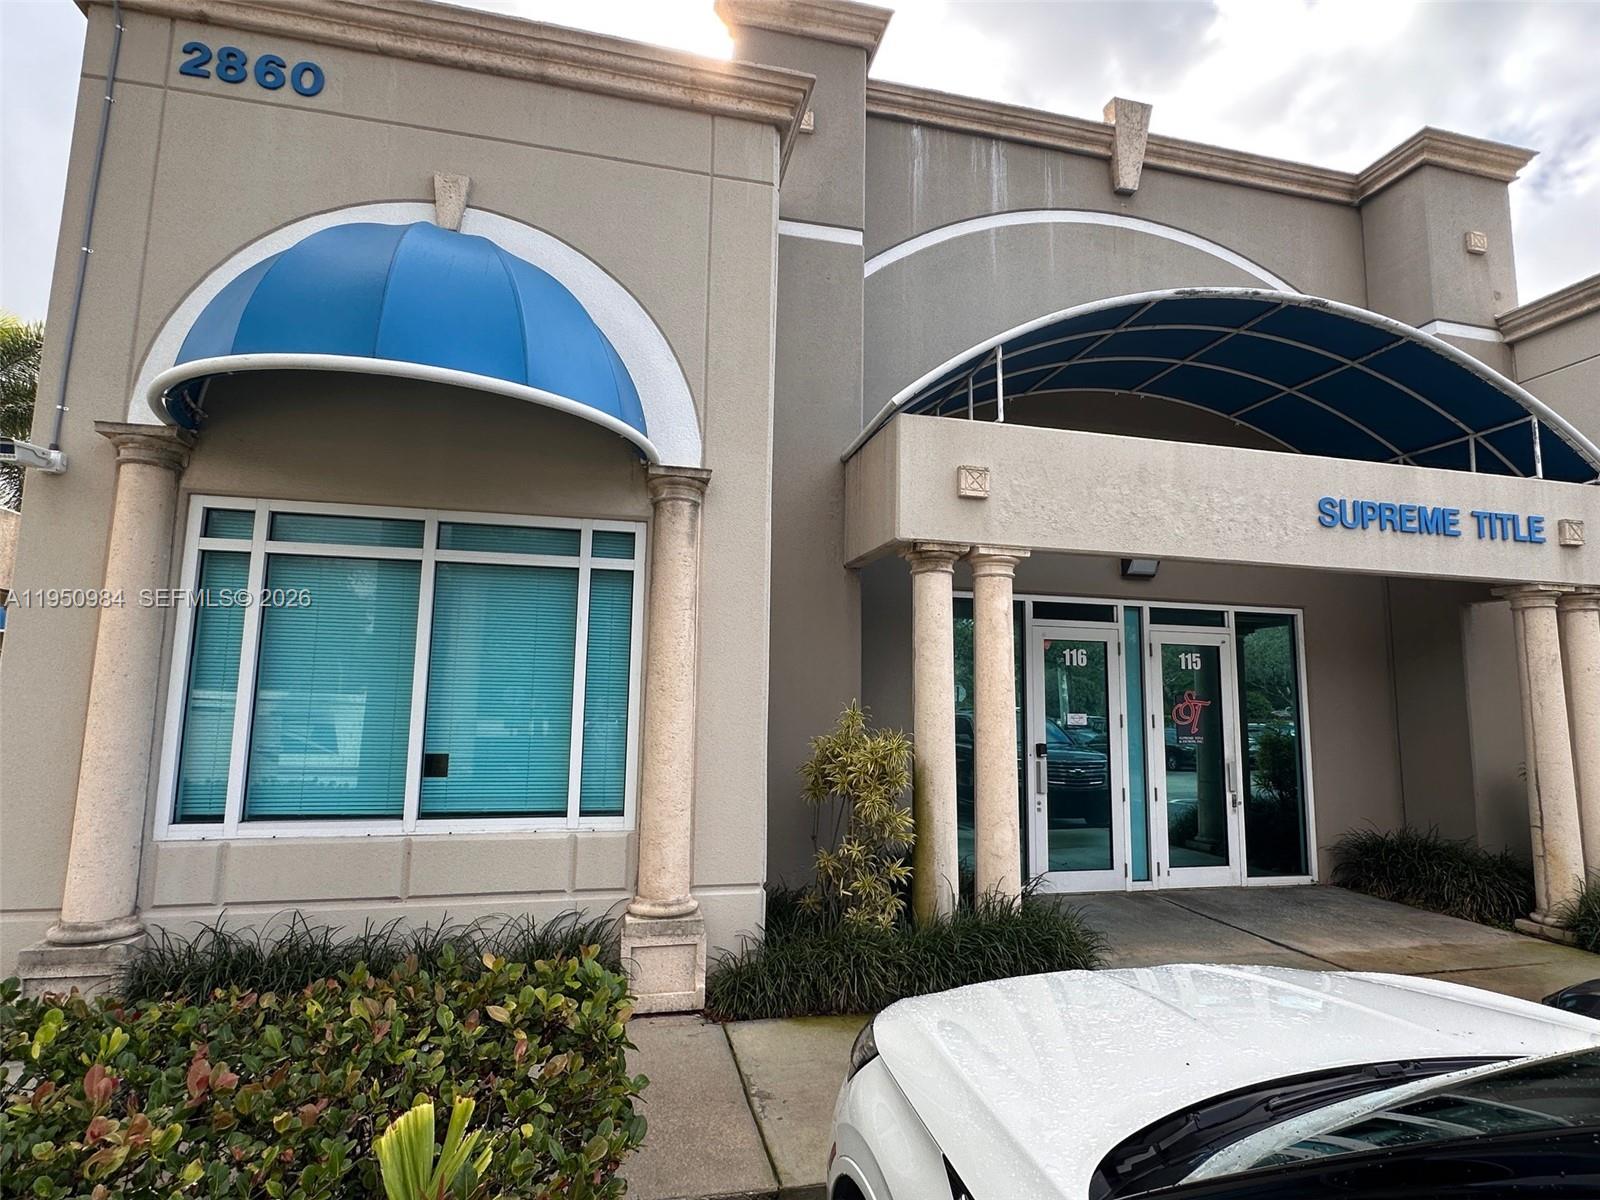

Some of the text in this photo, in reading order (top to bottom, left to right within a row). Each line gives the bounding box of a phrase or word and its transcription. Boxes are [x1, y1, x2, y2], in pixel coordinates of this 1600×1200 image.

[179, 41, 325, 97] 2860
[1318, 496, 1547, 544] SUPREME TITLE
[1062, 648, 1088, 667] 116
[1178, 652, 1202, 671] 115
